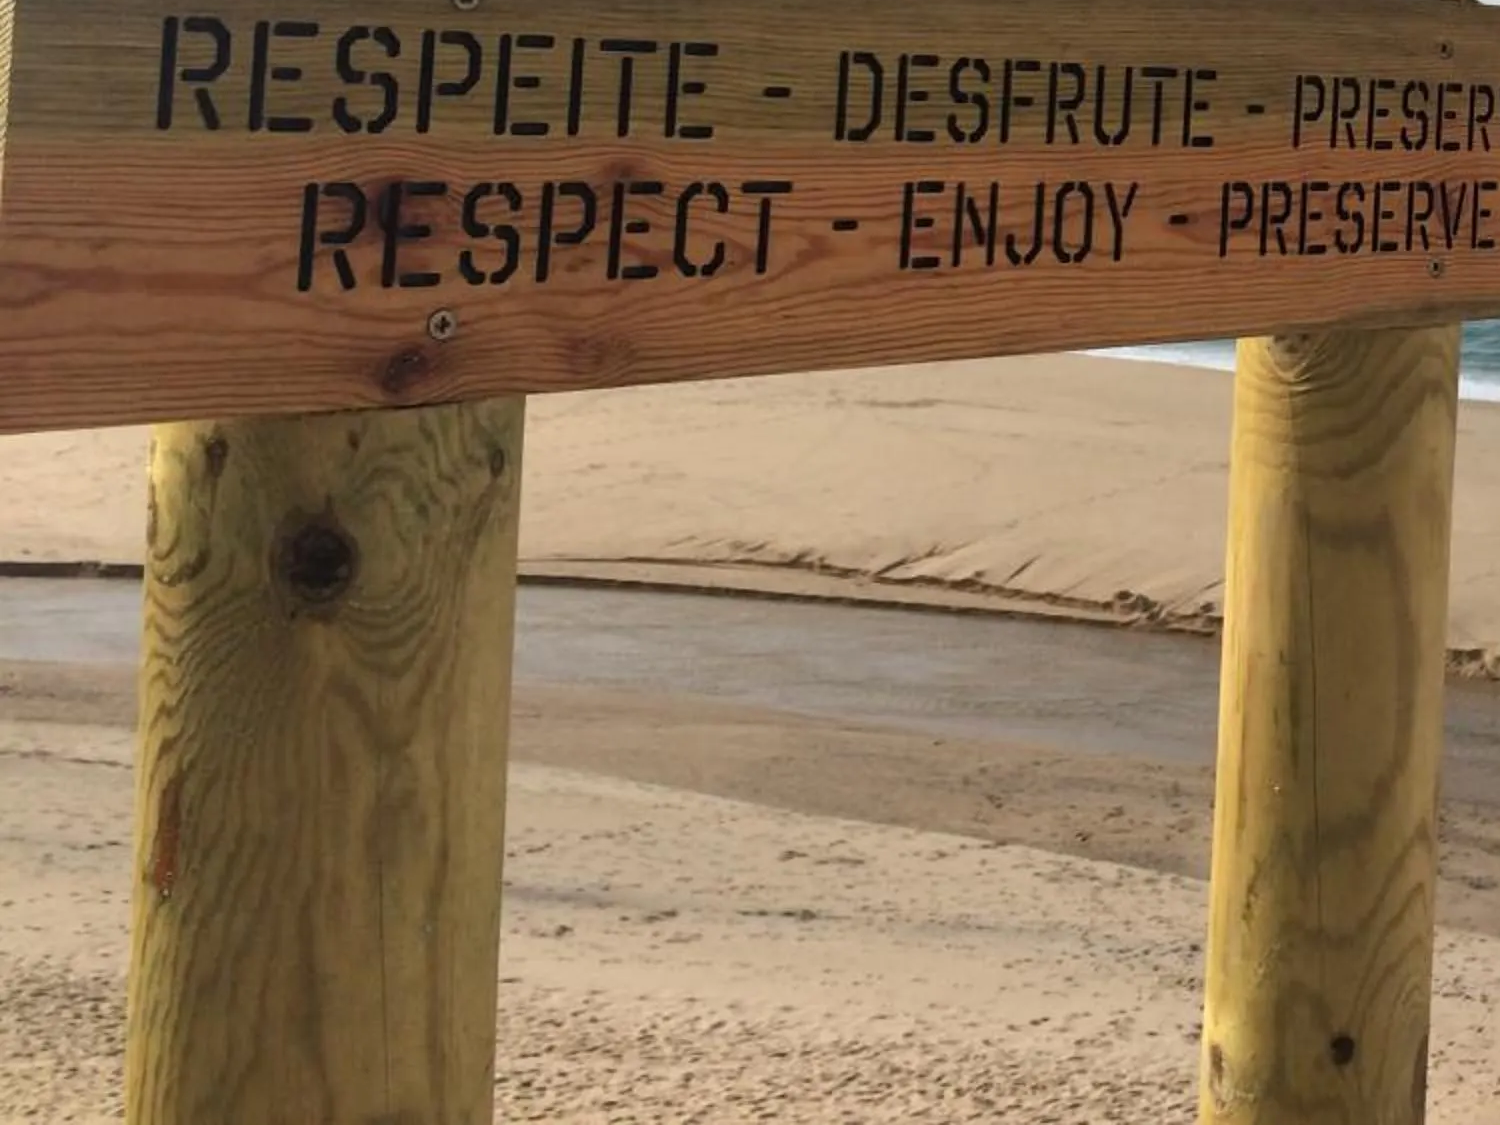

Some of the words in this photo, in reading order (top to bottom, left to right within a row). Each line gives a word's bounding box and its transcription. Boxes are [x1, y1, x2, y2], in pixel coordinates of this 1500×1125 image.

[155, 15, 719, 138] RESPEITE
[762, 86, 792, 98] -
[834, 50, 1217, 148] DESFRUTE
[296, 180, 794, 292] RESPECT
[831, 219, 859, 231] -
[899, 180, 1139, 270] ENJOY
[1218, 180, 1499, 258] PRESERVE
